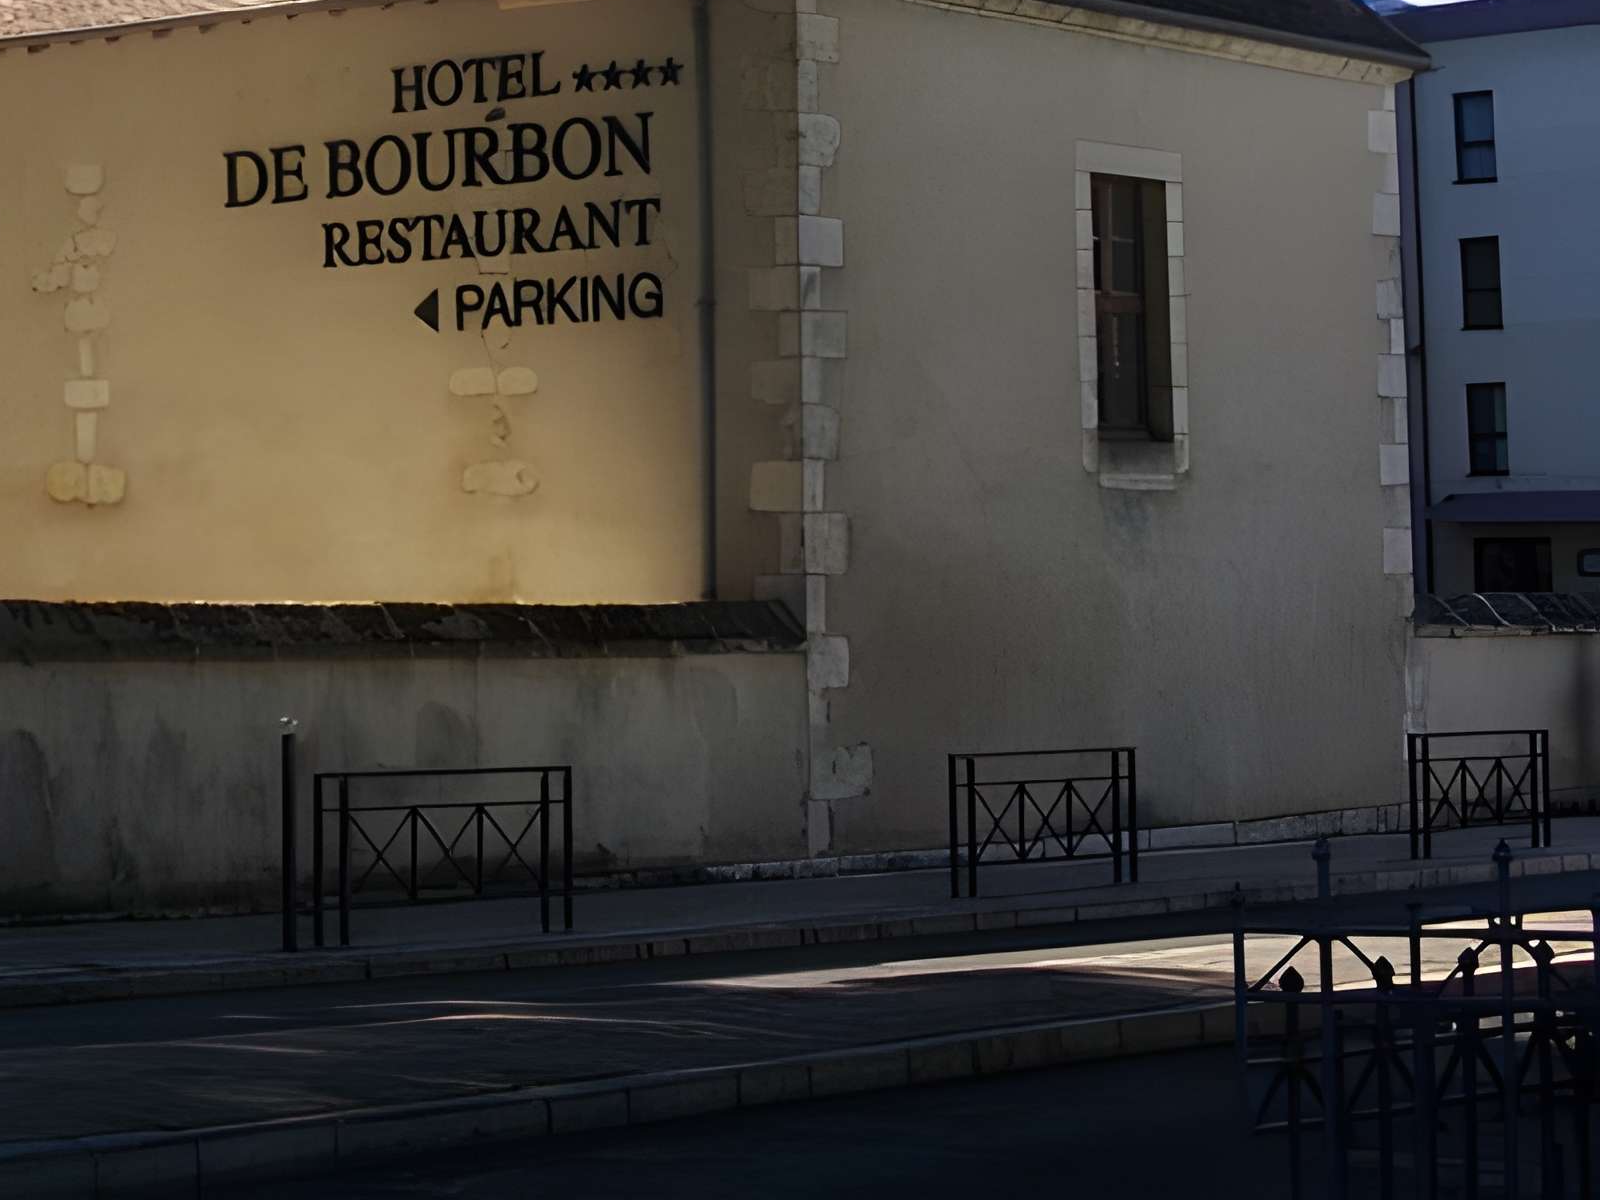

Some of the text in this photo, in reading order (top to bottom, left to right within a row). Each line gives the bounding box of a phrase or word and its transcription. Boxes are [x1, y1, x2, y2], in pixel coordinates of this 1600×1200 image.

[392, 51, 560, 112] HOTEL
[222, 112, 654, 208] DE BOURBON
[322, 198, 661, 268] RESTAURANT
[456, 272, 663, 331] PARKING
